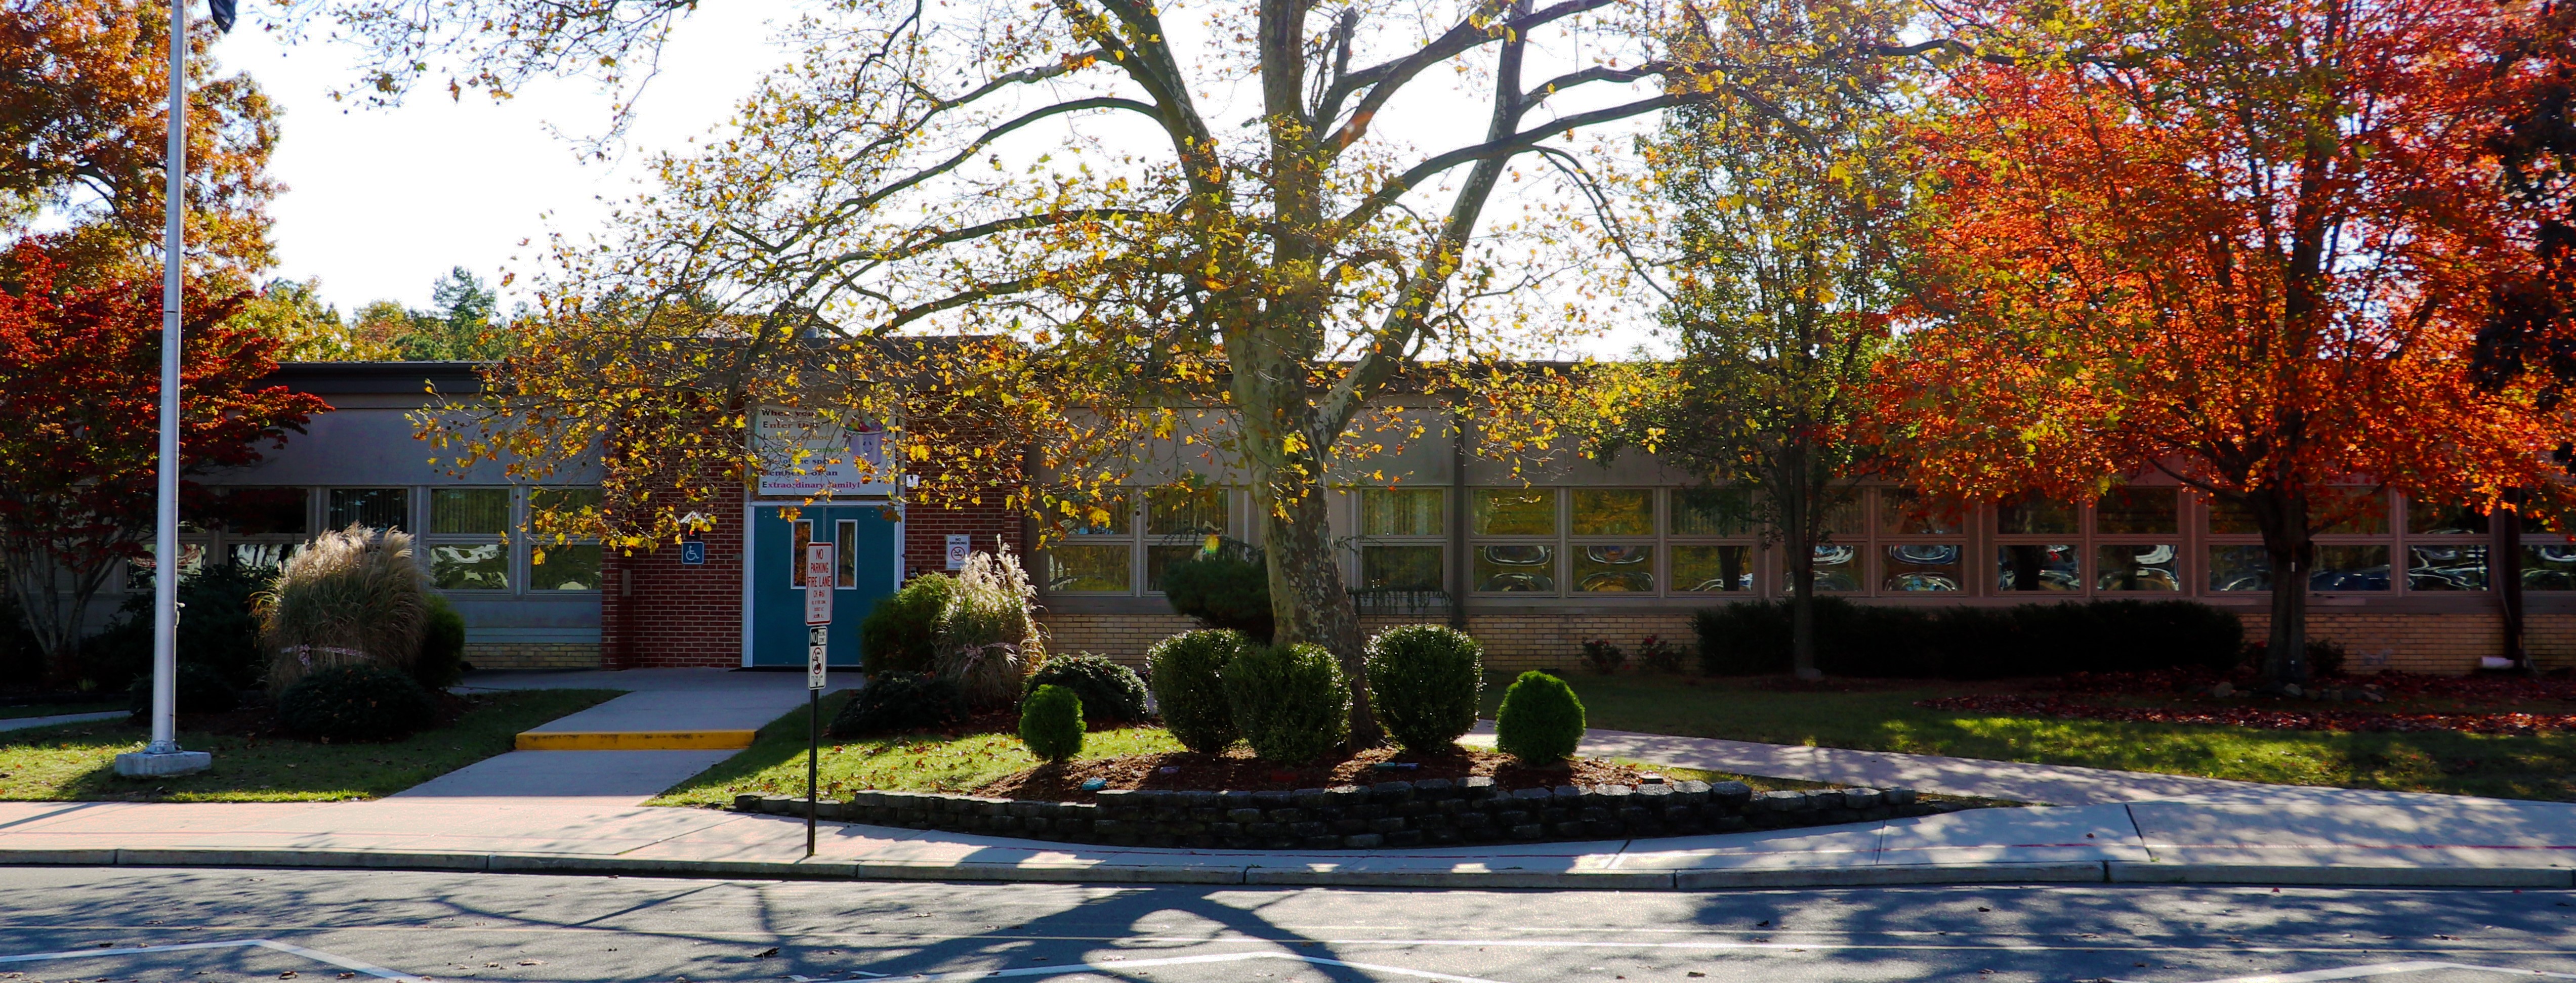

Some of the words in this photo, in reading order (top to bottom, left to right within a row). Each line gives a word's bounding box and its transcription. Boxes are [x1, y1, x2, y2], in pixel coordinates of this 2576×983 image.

[816, 548, 823, 560] NO
[811, 563, 828, 573] PARKING
[808, 576, 817, 587] FIRE
[819, 576, 831, 587] LANE
[810, 632, 818, 643] NO
